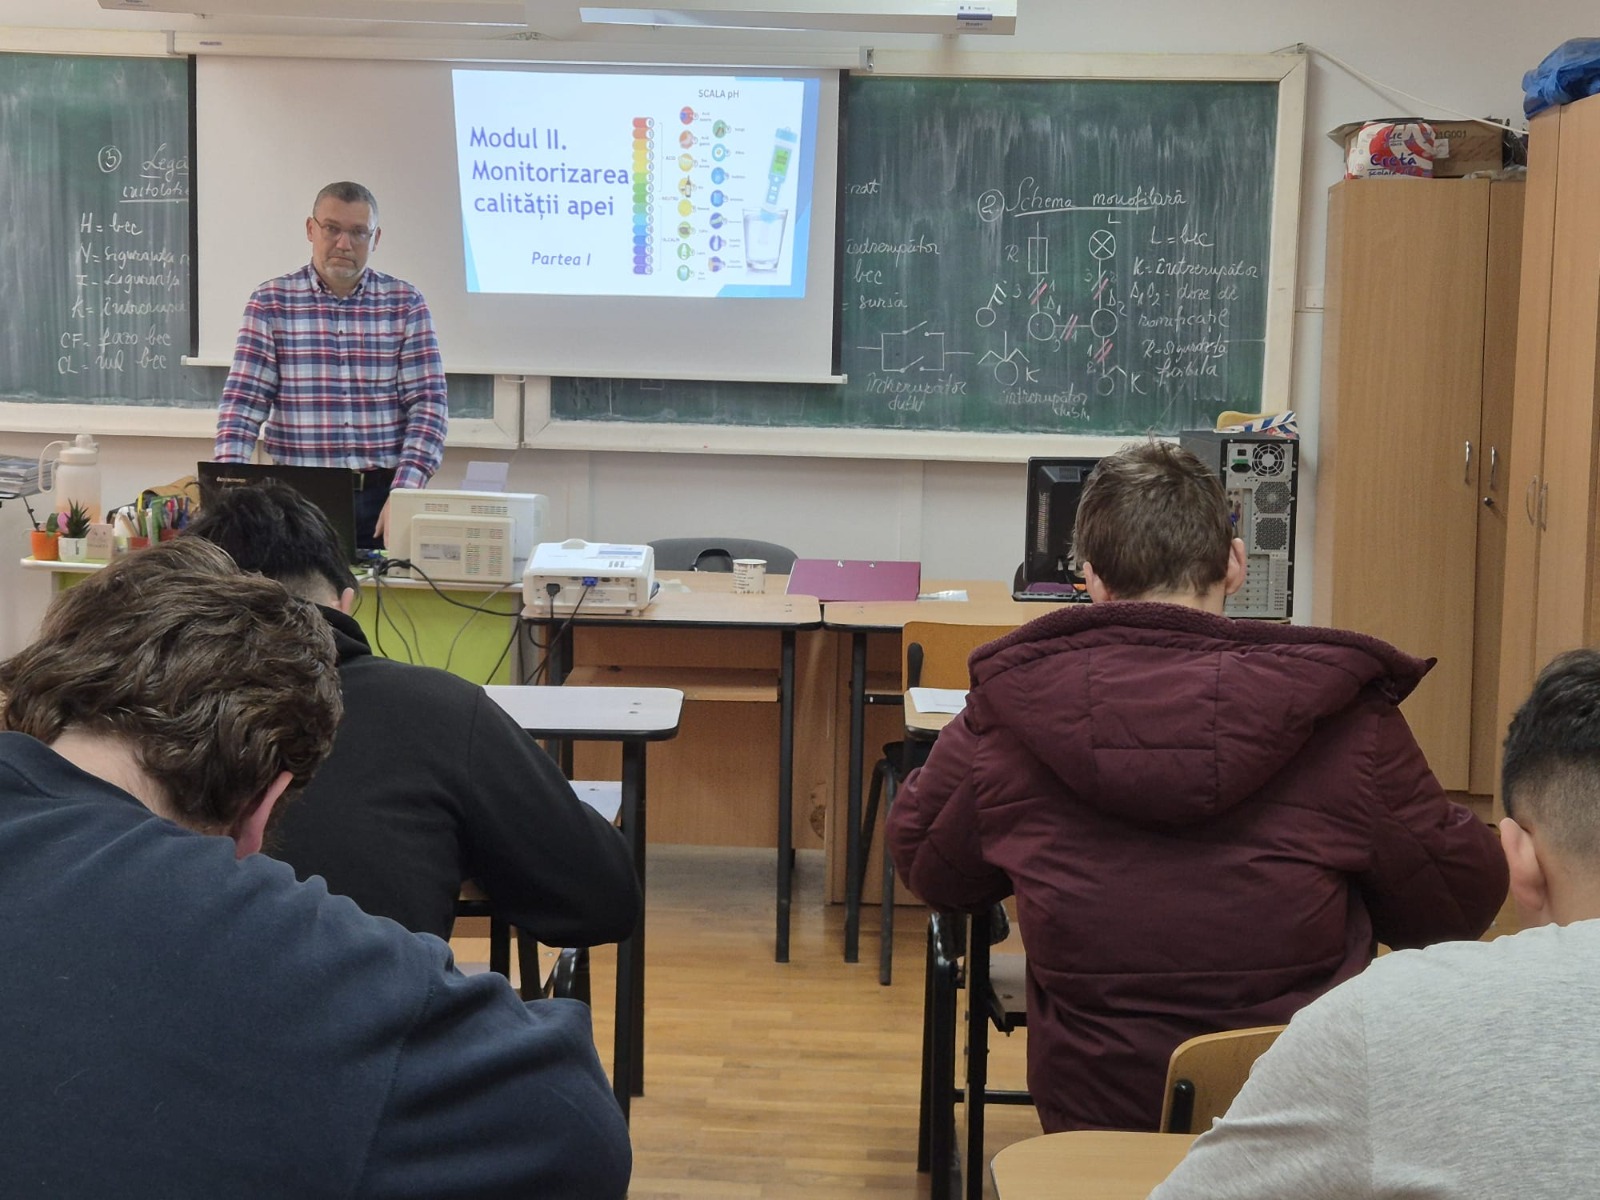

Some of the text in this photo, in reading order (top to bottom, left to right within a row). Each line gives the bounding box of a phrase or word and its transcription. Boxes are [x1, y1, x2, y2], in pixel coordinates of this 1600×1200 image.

[698, 89, 740, 100] SCALA pH
[470, 126, 567, 150] Modul II.
[472, 160, 629, 184] Monitorizarea
[474, 192, 614, 220] calității apei
[1006, 177, 1074, 212] Schema
[109, 212, 144, 236] bec
[532, 251, 581, 266] Partea
[1130, 372, 1148, 396] K
